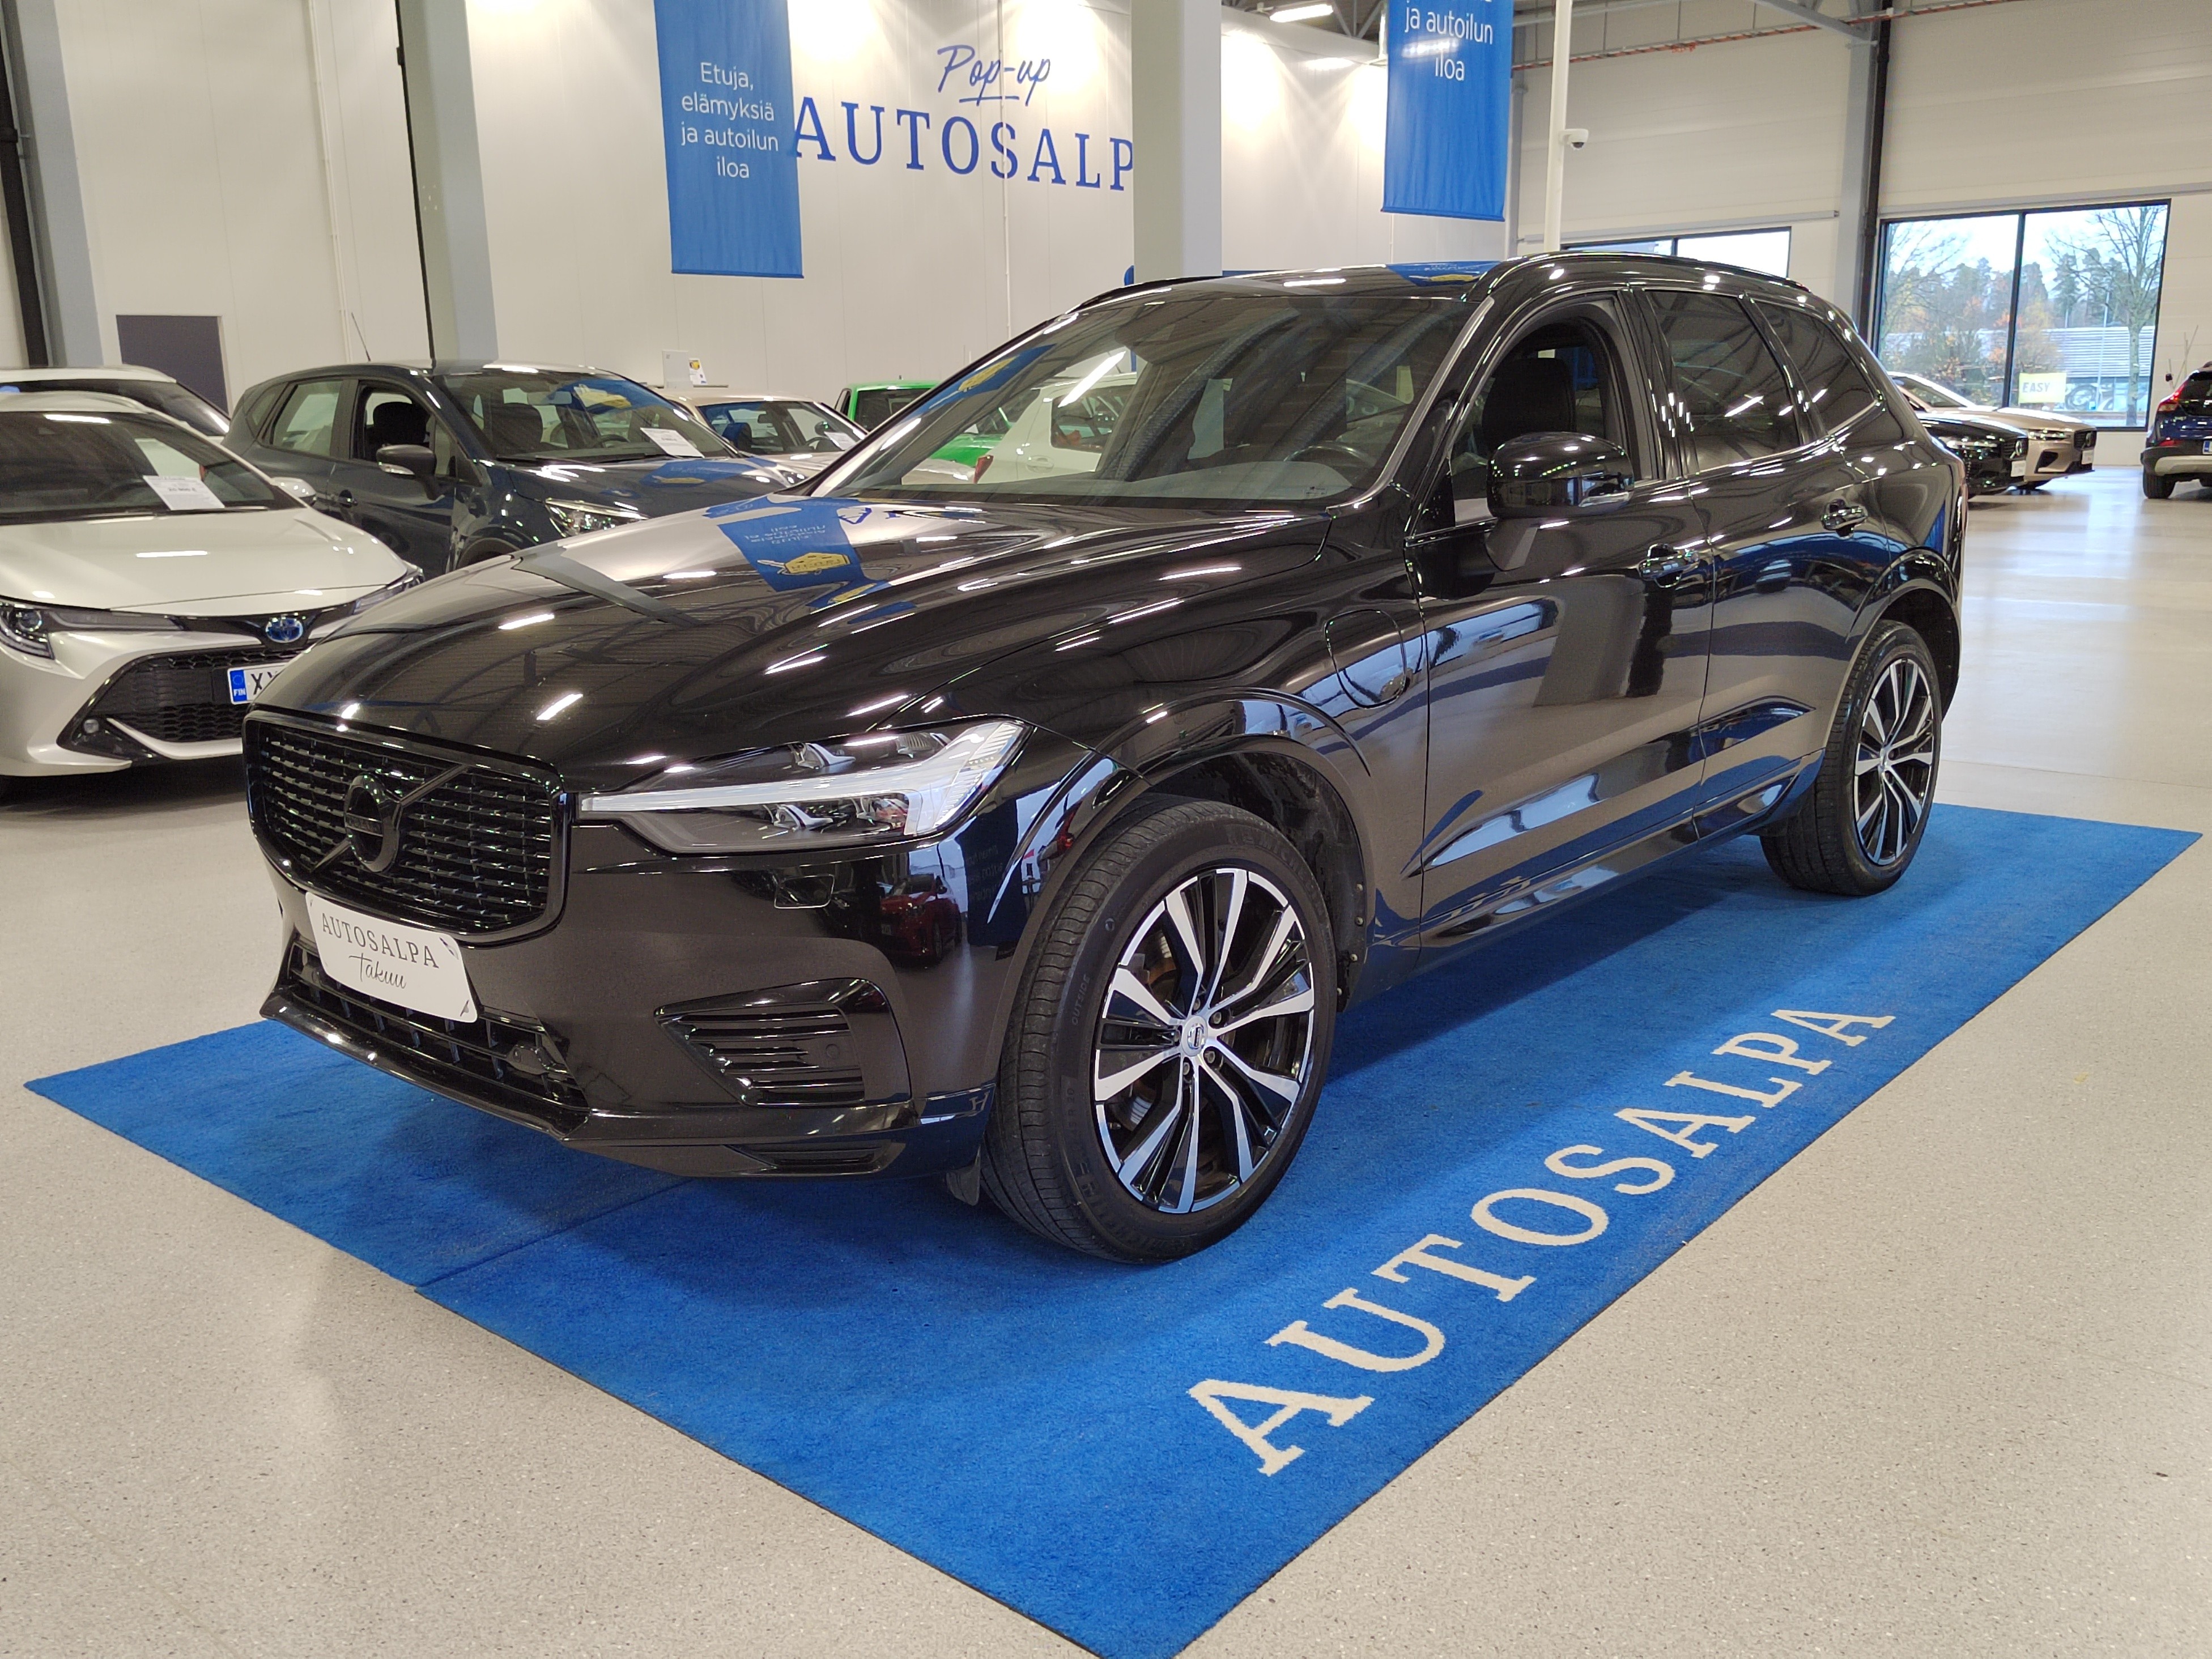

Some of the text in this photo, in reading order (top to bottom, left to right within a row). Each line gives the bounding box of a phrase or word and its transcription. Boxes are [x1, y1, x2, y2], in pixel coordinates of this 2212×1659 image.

[1404, 0, 1494, 45] ja autoilun
[700, 62, 754, 91] Etuja,
[937, 44, 1051, 107] Pop-up
[1435, 50, 1465, 81] iloa
[681, 91, 775, 121] elämyksiä
[681, 121, 779, 152] ja autoilun
[716, 155, 750, 178] iloa
[2022, 381, 2051, 393] EASY
[321, 912, 440, 969] AUTOSALPA
[348, 952, 407, 989] Takuu
[1071, 972, 1091, 1027] OUTSIDE
[1187, 1008, 1896, 1476] AUTOSALPA
